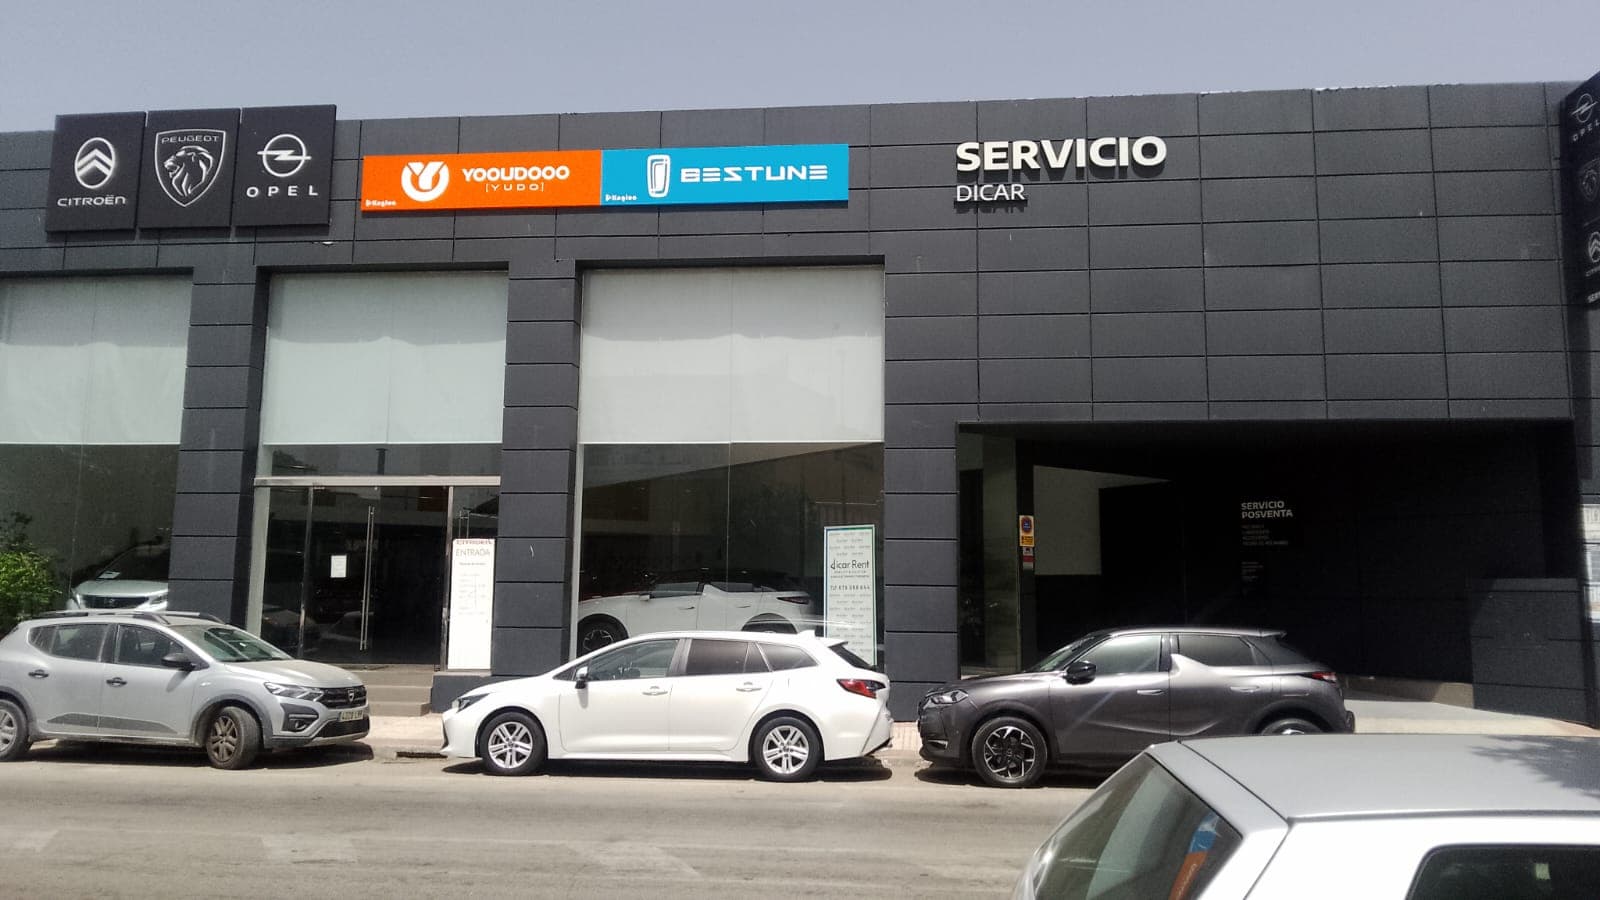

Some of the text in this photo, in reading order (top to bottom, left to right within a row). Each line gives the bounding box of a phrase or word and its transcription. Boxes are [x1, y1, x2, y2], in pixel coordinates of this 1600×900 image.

[161, 135, 220, 144] PEUGEOT
[956, 135, 1167, 172] SERVICIO
[462, 165, 570, 182] YOOUDOOO
[680, 164, 828, 183] BESTUNE
[246, 185, 319, 198] OPEL
[956, 184, 1026, 202] DICAR
[57, 194, 126, 207] CITROËN
[1241, 500, 1285, 510] SERVICIO
[1241, 509, 1293, 519] POSVENTA
[456, 548, 490, 557] ENTRADA
